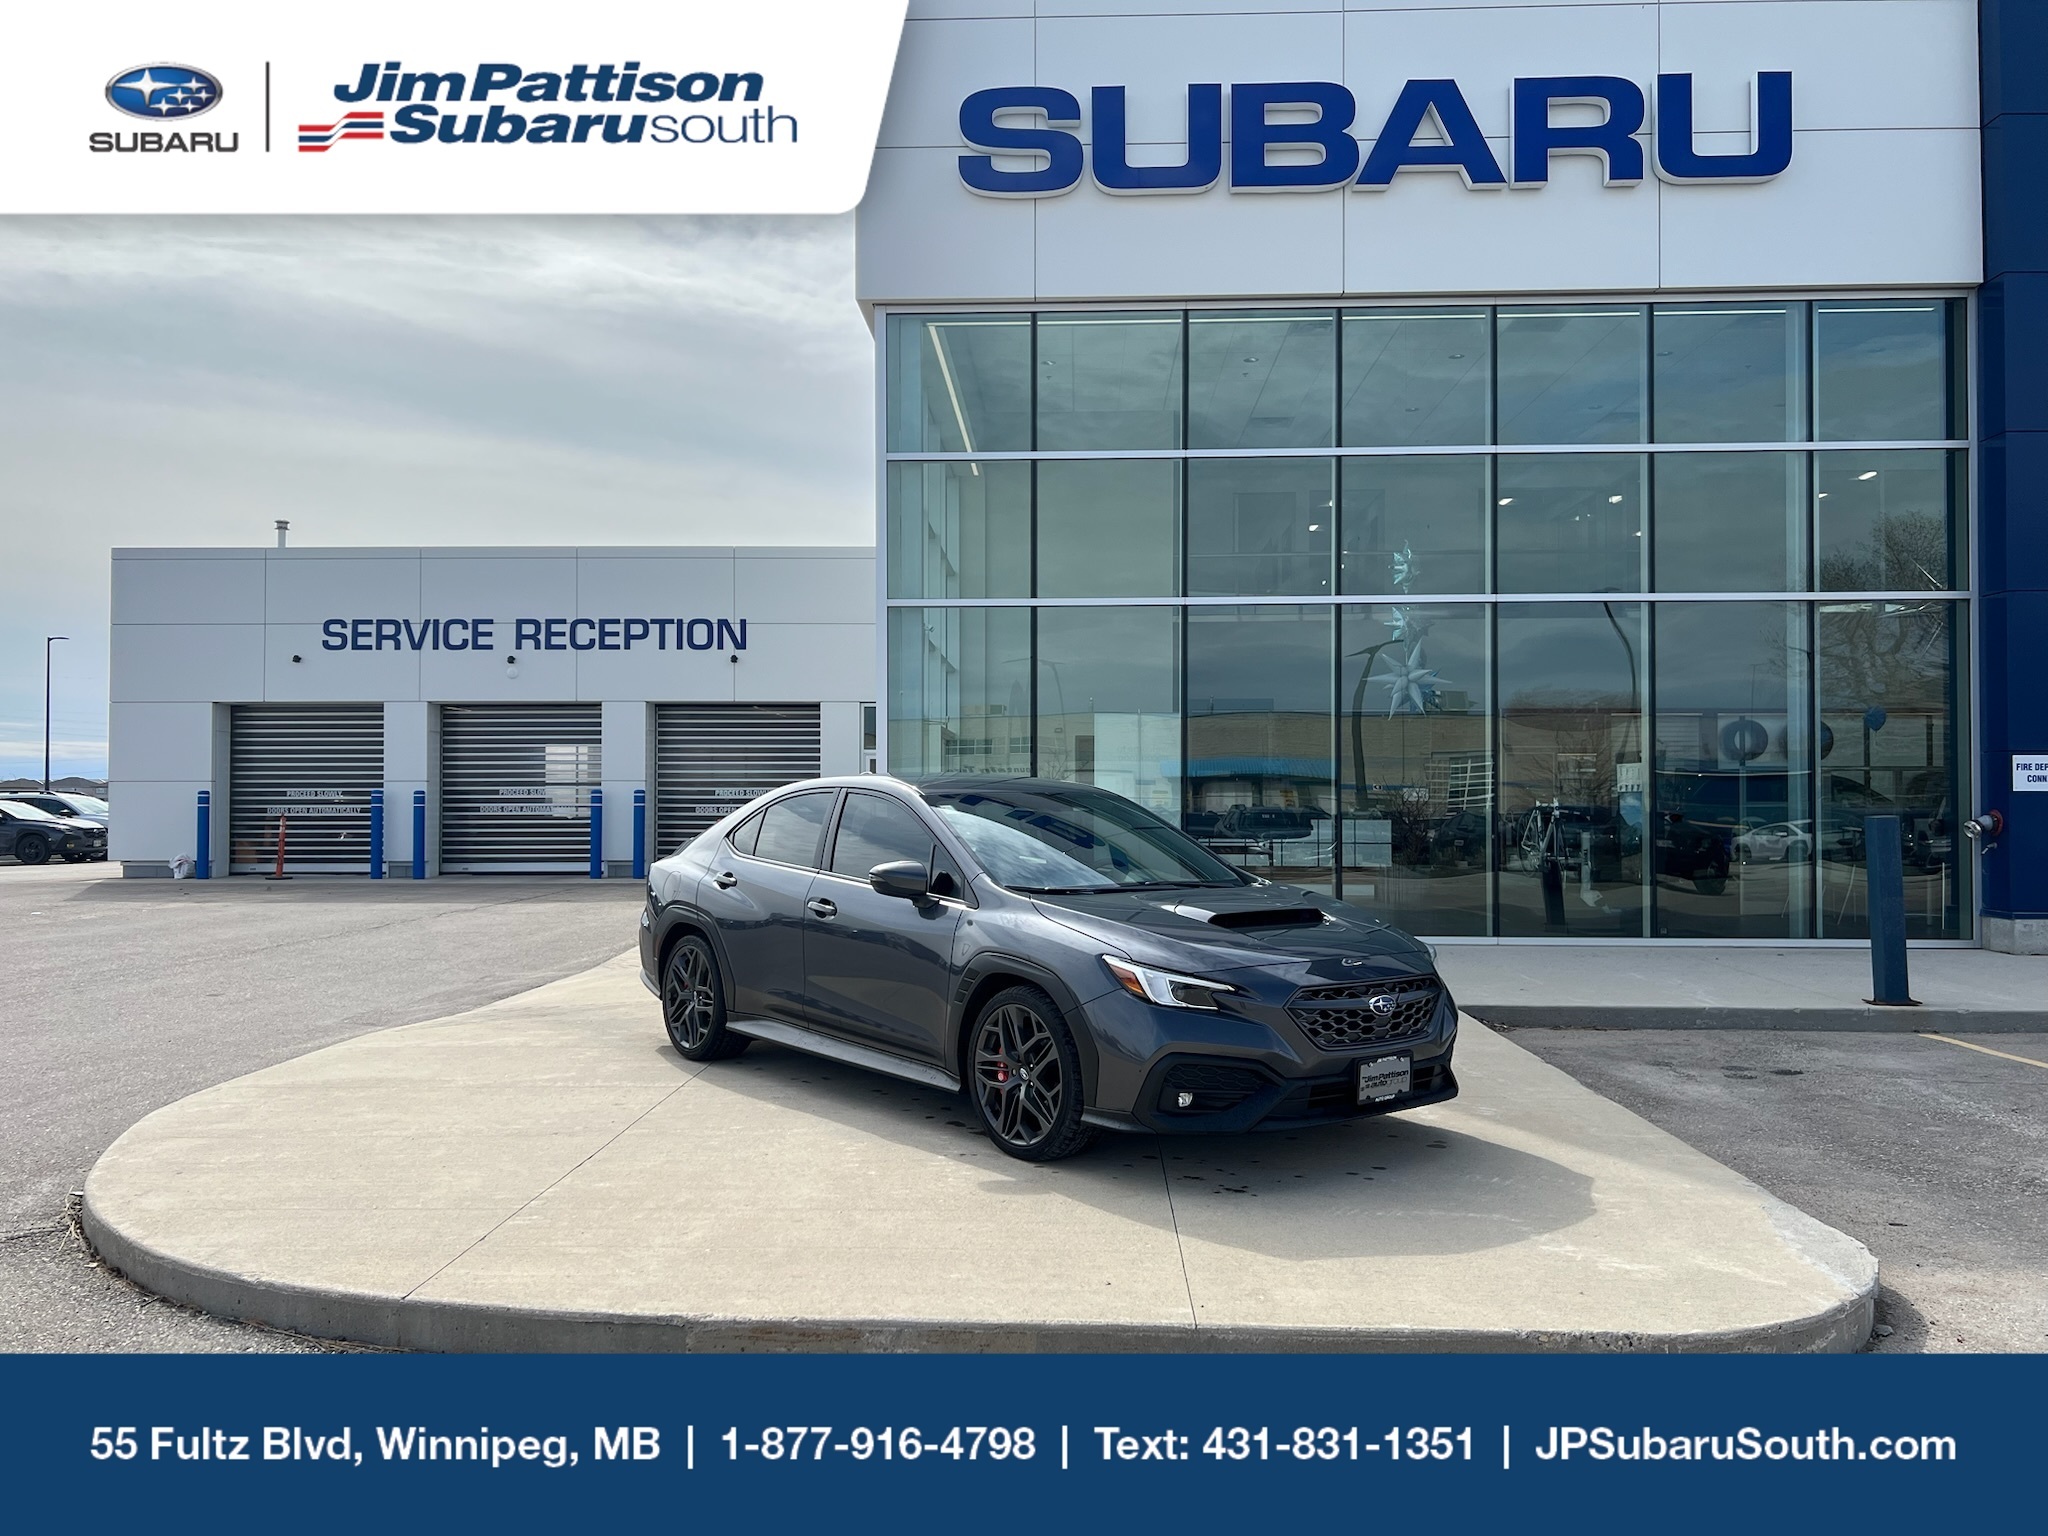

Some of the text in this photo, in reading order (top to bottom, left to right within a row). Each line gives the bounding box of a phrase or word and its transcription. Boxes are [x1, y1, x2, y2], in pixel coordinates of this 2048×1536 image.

[958, 71, 1793, 195] SUBARU
[322, 618, 748, 651] SERVICE RECEPTION
[2016, 763, 2033, 771] FIRE
[286, 790, 316, 798] PROCEED
[714, 789, 745, 797] PROCEED
[267, 807, 361, 815] DOORS OPEN AUTOMATICALLY
[694, 806, 717, 814] DOORS
